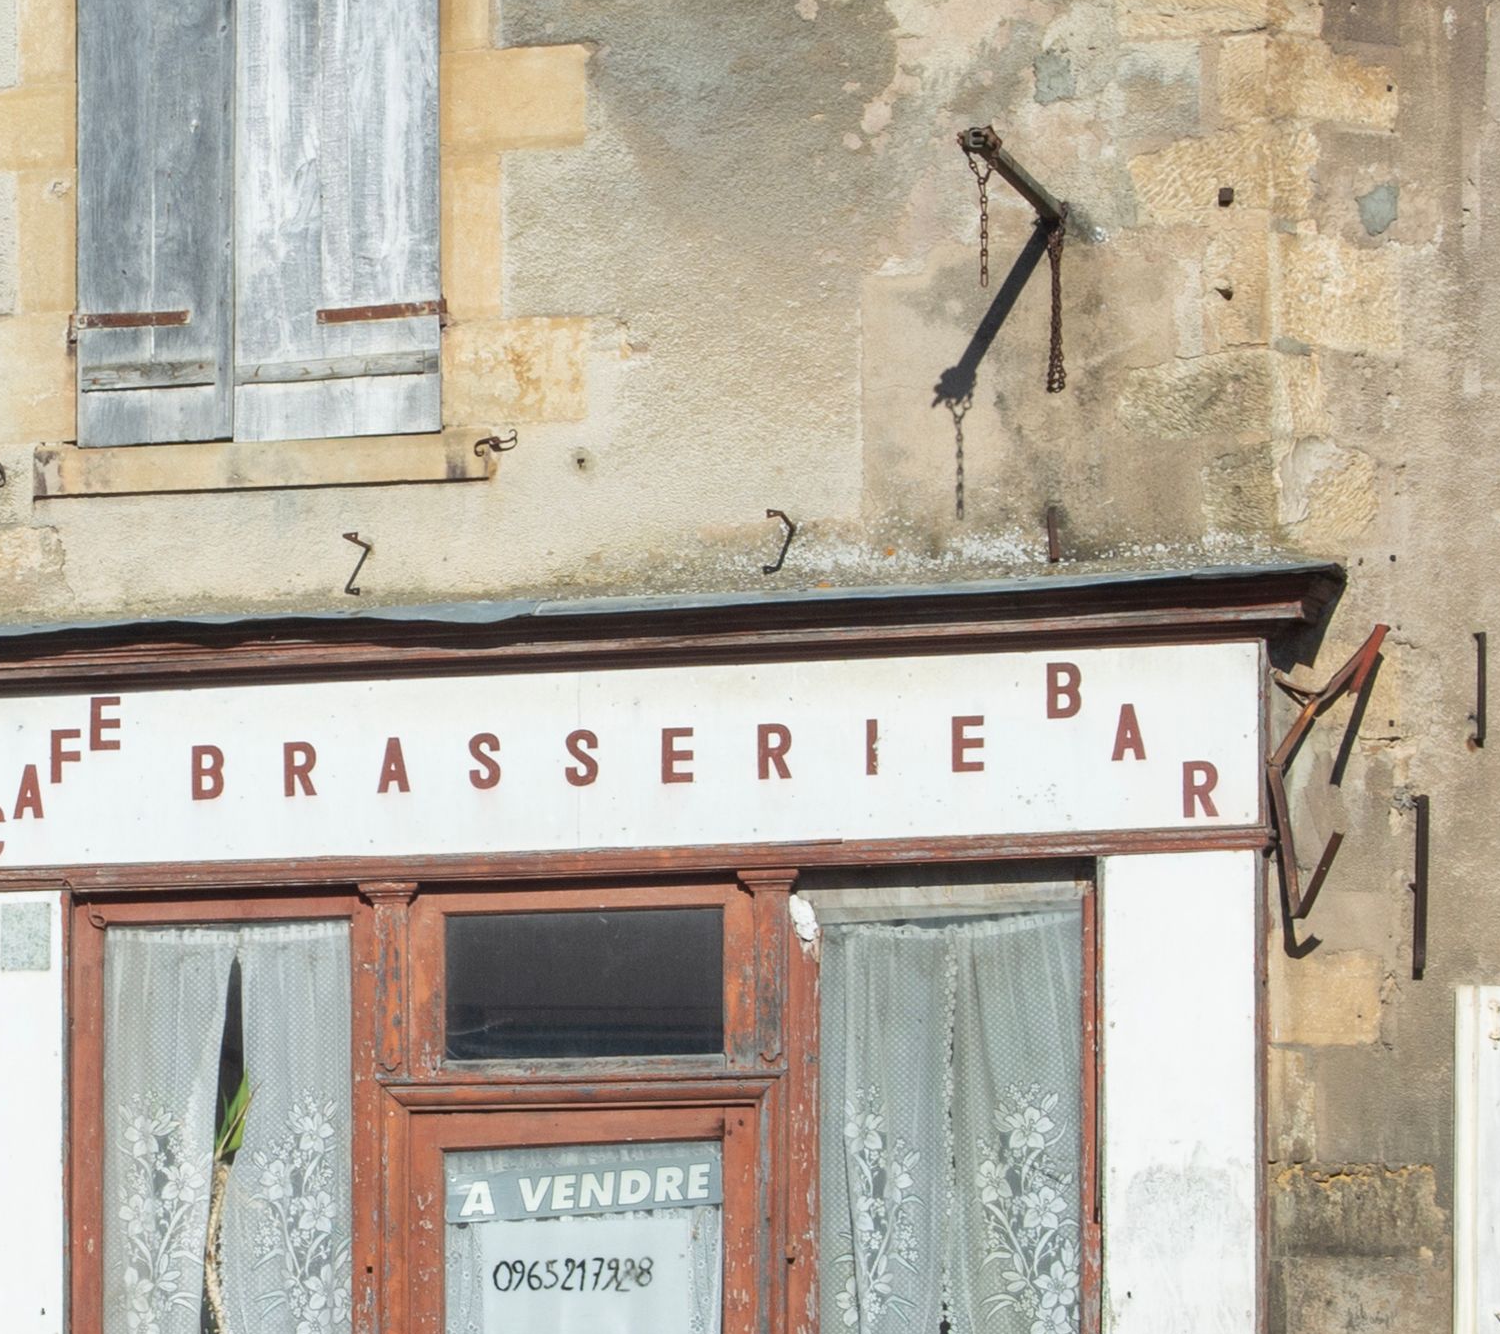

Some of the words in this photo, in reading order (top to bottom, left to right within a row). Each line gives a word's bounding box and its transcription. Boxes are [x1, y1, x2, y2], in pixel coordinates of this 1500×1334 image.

[191, 715, 985, 801] BRASSERIE
[1046, 661, 1219, 819] BAR
[458, 1180, 497, 1218] A
[517, 1162, 712, 1214] VENDRE
